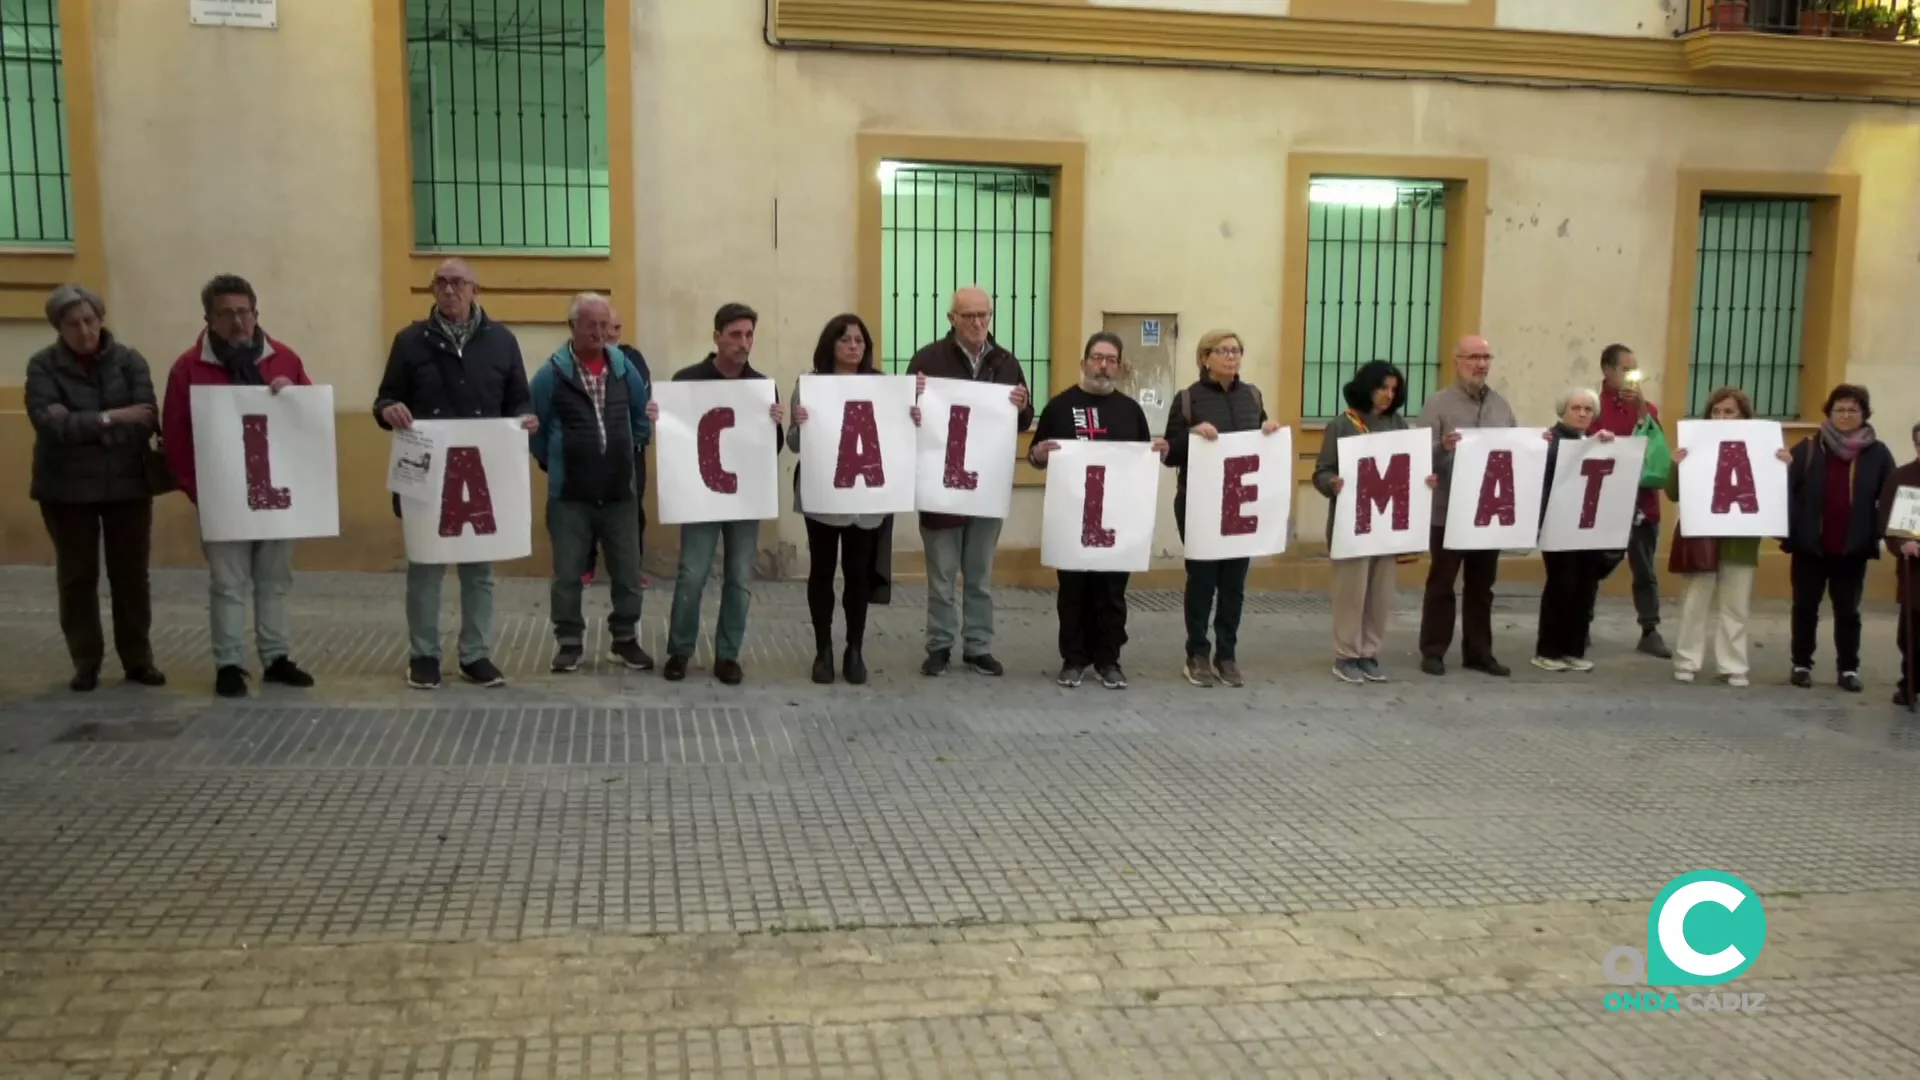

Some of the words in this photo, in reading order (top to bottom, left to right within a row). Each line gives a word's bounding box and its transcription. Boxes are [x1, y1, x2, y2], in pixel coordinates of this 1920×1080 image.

[243, 415, 291, 510] L
[697, 406, 738, 494] C
[834, 400, 885, 488] A
[943, 404, 978, 490] L
[1711, 441, 1759, 514] A
[438, 446, 497, 537] A
[1081, 465, 1116, 548] L
[1221, 455, 1259, 536] E
[1355, 453, 1411, 534] M
[1475, 450, 1515, 526] A
[1579, 458, 1616, 529] T
